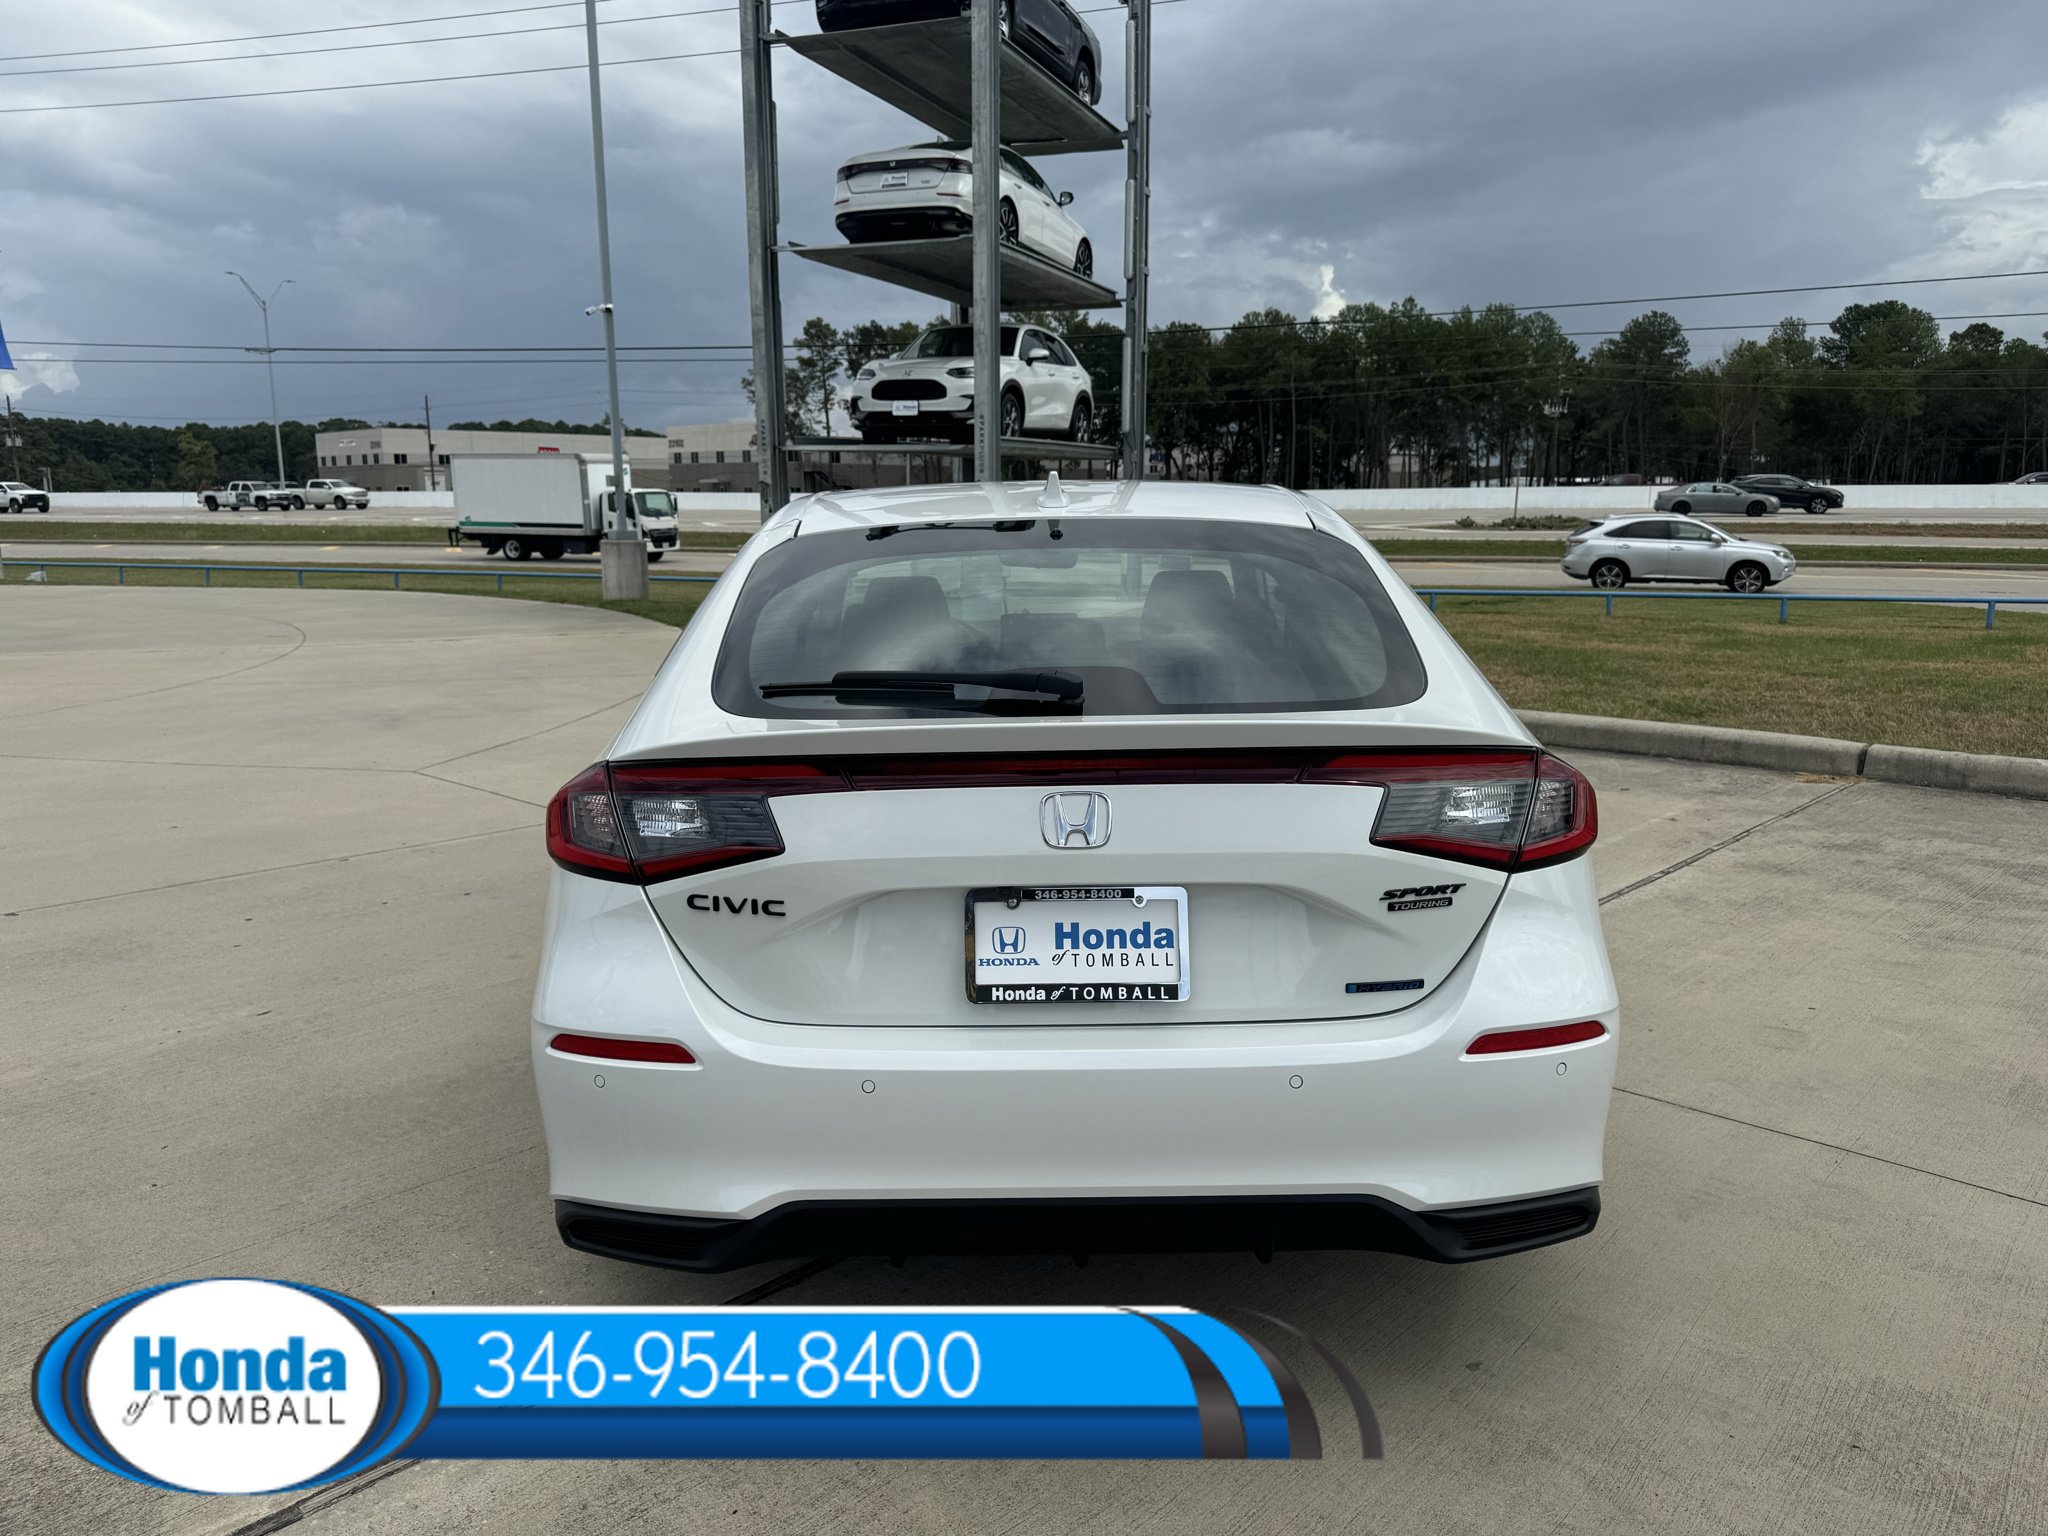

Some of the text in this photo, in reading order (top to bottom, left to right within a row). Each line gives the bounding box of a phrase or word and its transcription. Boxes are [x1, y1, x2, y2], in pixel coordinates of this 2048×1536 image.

[1034, 889, 1122, 900] 346-954-8400
[1378, 883, 1467, 901] SPORT
[686, 893, 787, 917] CIVIC
[1393, 899, 1449, 911] TOURING
[1054, 921, 1175, 950] Honda
[978, 957, 1040, 967] HONDA
[1051, 950, 1174, 968] of TOMBALL
[991, 985, 1169, 1001] Honda of TOMBALL
